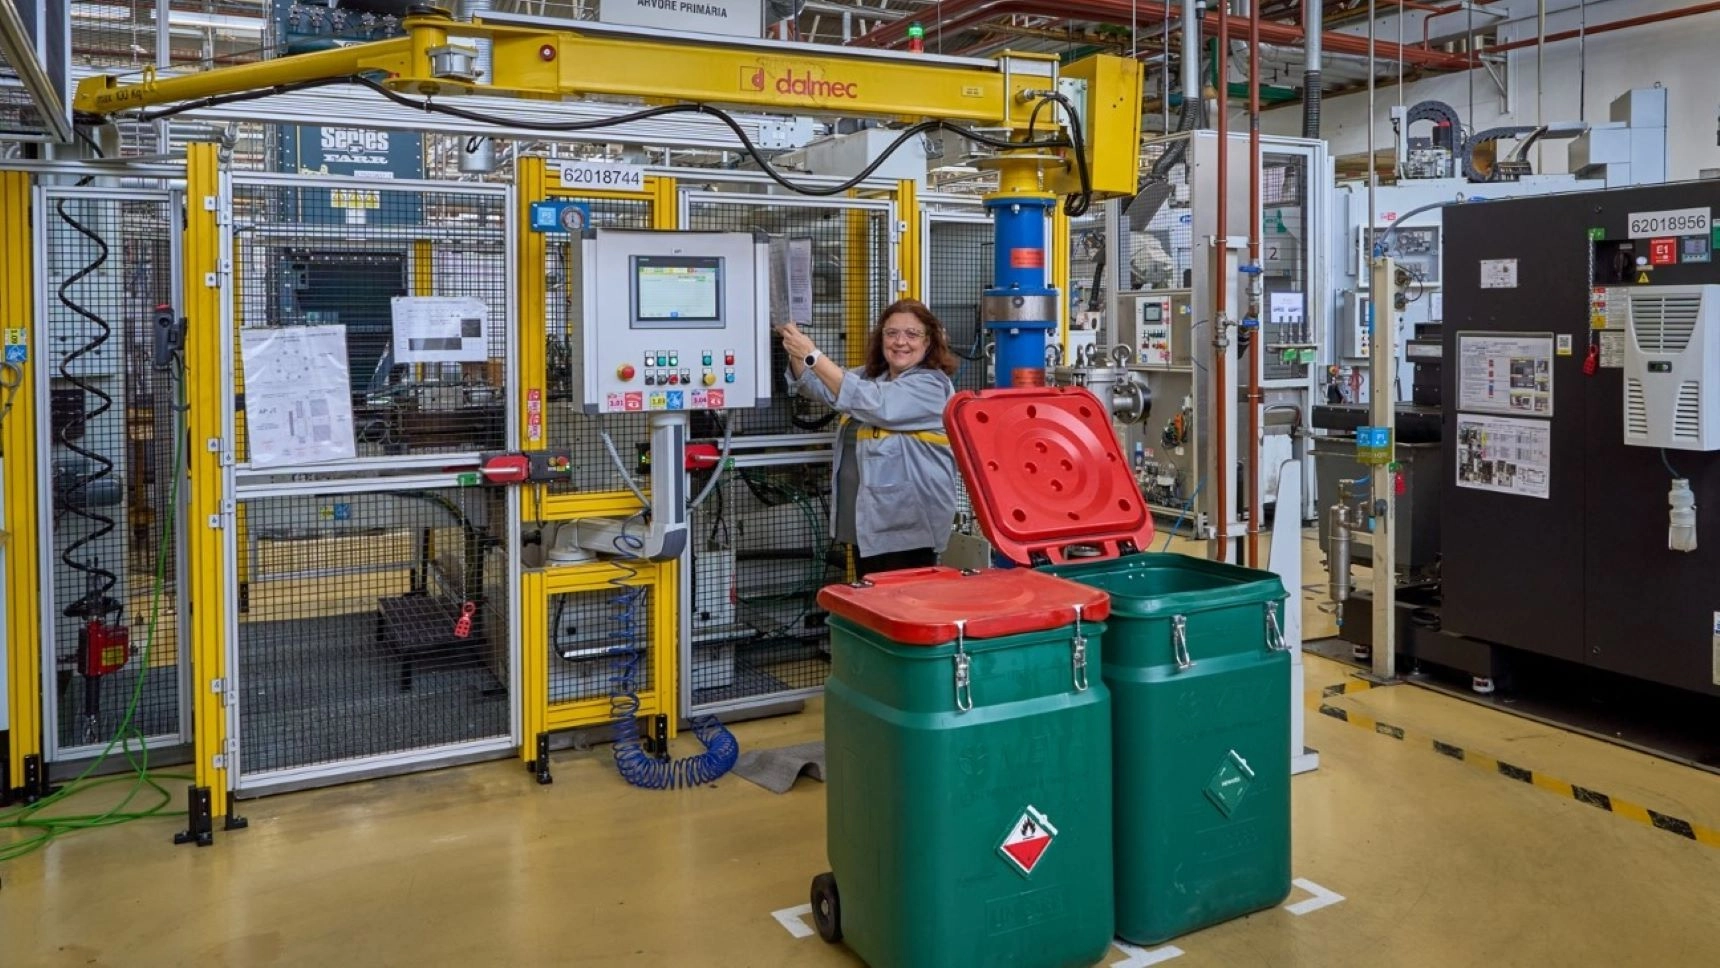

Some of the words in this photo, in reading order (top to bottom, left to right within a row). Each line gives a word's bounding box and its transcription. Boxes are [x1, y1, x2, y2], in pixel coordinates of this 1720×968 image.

[775, 68, 858, 99] dalmec
[320, 126, 390, 152] Series
[323, 153, 388, 164] FARR
[563, 167, 640, 185] 62018744
[1631, 214, 1707, 233] 62018956
[1270, 246, 1278, 260] 2
